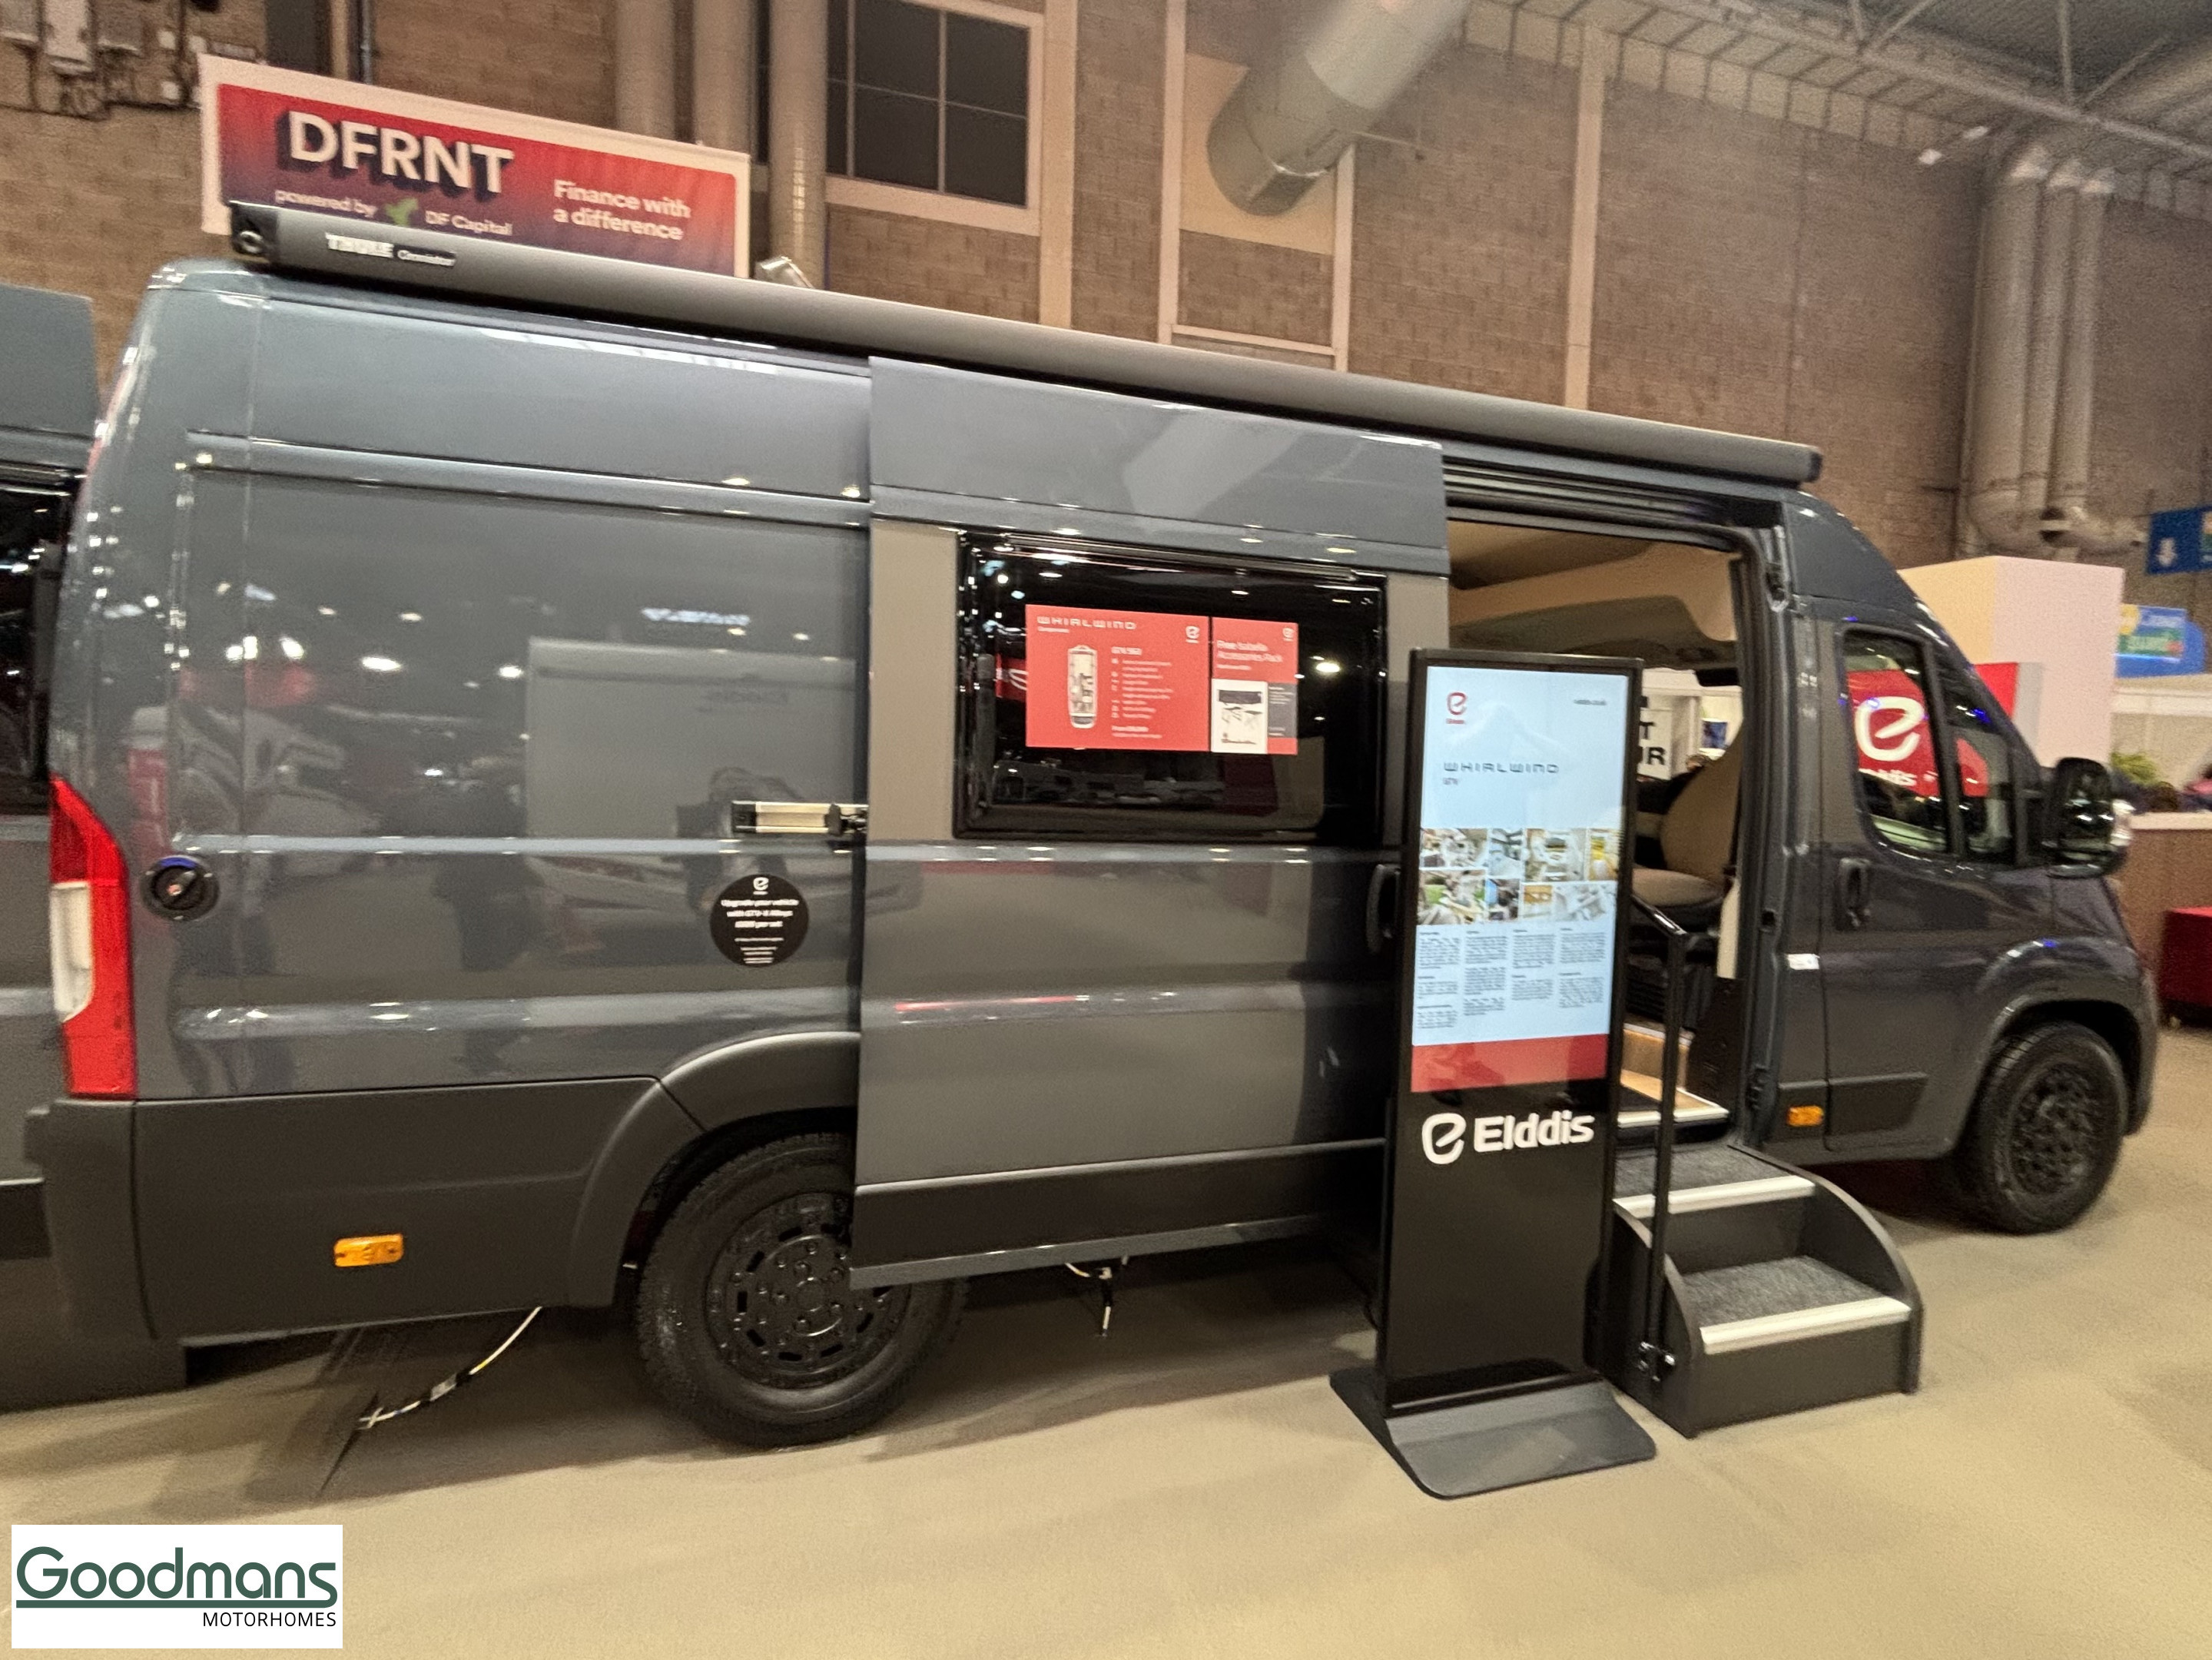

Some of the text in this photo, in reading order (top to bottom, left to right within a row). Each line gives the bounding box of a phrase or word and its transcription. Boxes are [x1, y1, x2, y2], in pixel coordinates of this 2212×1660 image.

[287, 110, 516, 194] DFRNT
[274, 189, 378, 218] powered by
[553, 178, 691, 219] Finance with
[425, 210, 513, 236] DF Capital
[552, 207, 685, 241] a difference
[1443, 762, 1560, 774] WHIRLWIND
[1474, 1109, 1596, 1153] Elddis
